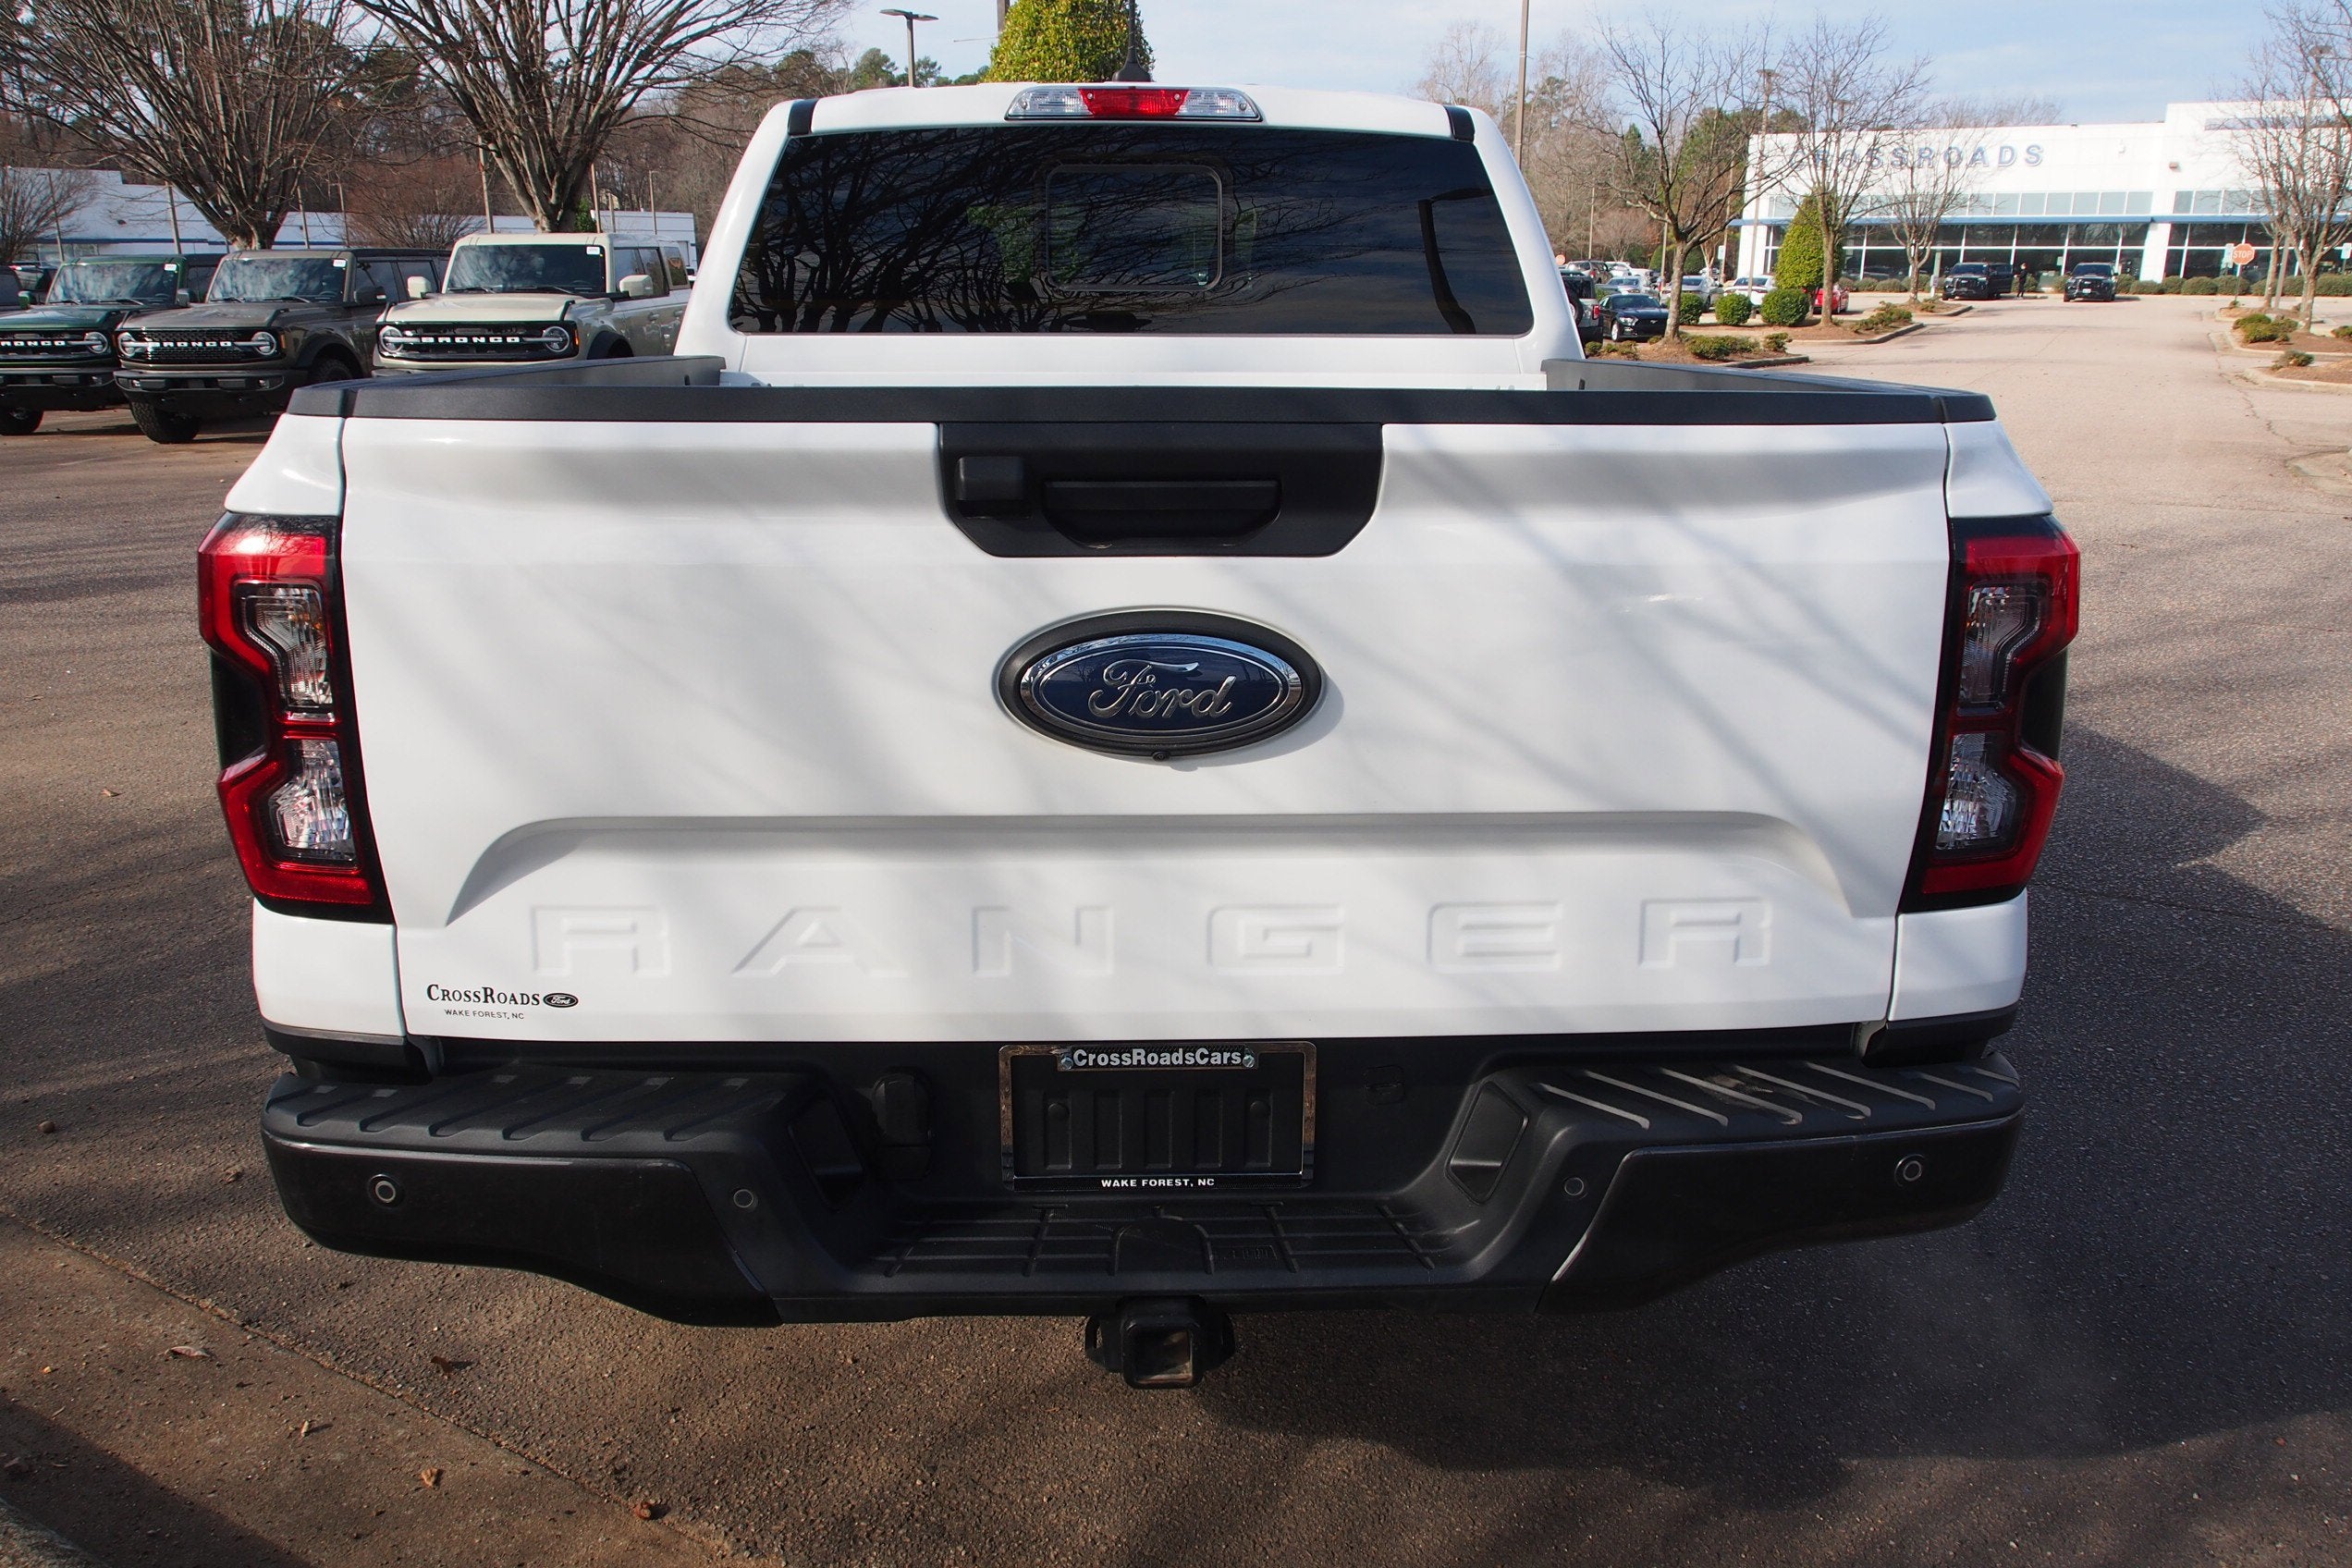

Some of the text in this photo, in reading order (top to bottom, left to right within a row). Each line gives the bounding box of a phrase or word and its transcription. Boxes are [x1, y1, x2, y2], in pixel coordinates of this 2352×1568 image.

[1791, 143, 2045, 170] CROSSROADS
[2233, 251, 2253, 259] STOP
[1087, 658, 1237, 719] Ford
[529, 897, 1774, 978] RANGER
[444, 1009, 471, 1017] WAKE
[472, 1010, 510, 1020] FOREST,
[1073, 1048, 1242, 1067] CrossRoadsCars
[1101, 1178, 1215, 1188] WAKE FOREST, NC
